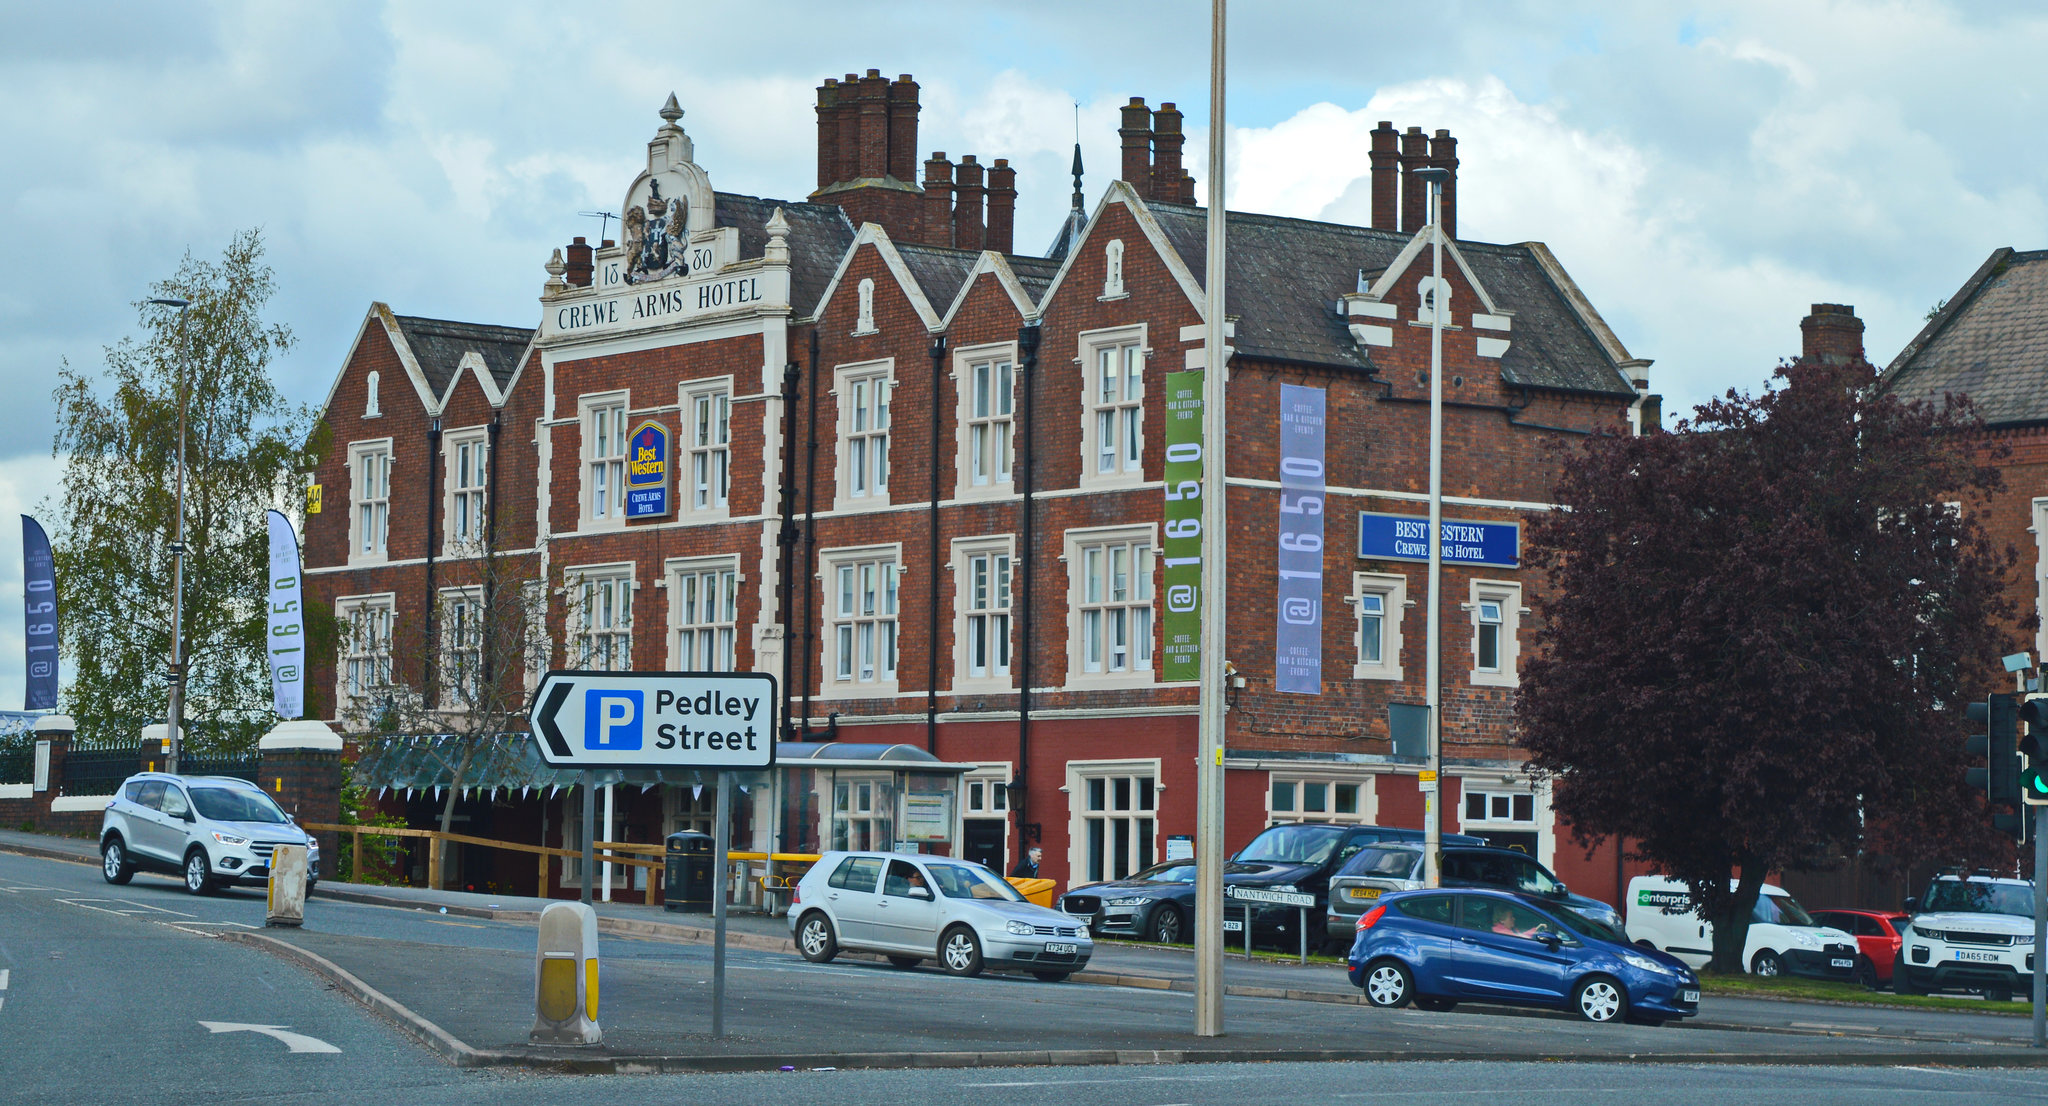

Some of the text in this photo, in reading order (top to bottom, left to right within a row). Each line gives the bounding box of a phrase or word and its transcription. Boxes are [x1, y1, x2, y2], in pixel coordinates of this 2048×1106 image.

[558, 277, 763, 330] CREWE ARMS HOTEL
[638, 446, 657, 462] Best
[631, 460, 664, 476] Western
[631, 491, 662, 503] CREWE ARMS
[638, 503, 654, 514] HOTEL
[1164, 442, 1202, 613] @1650
[1395, 520, 1485, 543] BEST ESTERN
[1279, 457, 1323, 625] @1650
[1395, 540, 1427, 556] CREWE
[1455, 544, 1485, 559] HOTEL
[27, 579, 55, 678] @1650
[272, 575, 301, 683] @1650
[655, 689, 760, 721] Pedley
[599, 696, 635, 745] P
[655, 723, 757, 751] Street
[1236, 889, 1312, 905] NANTWICH ROAD
[1640, 893, 1691, 905] enterpris
[1961, 951, 1999, 962] DA65 EOM
